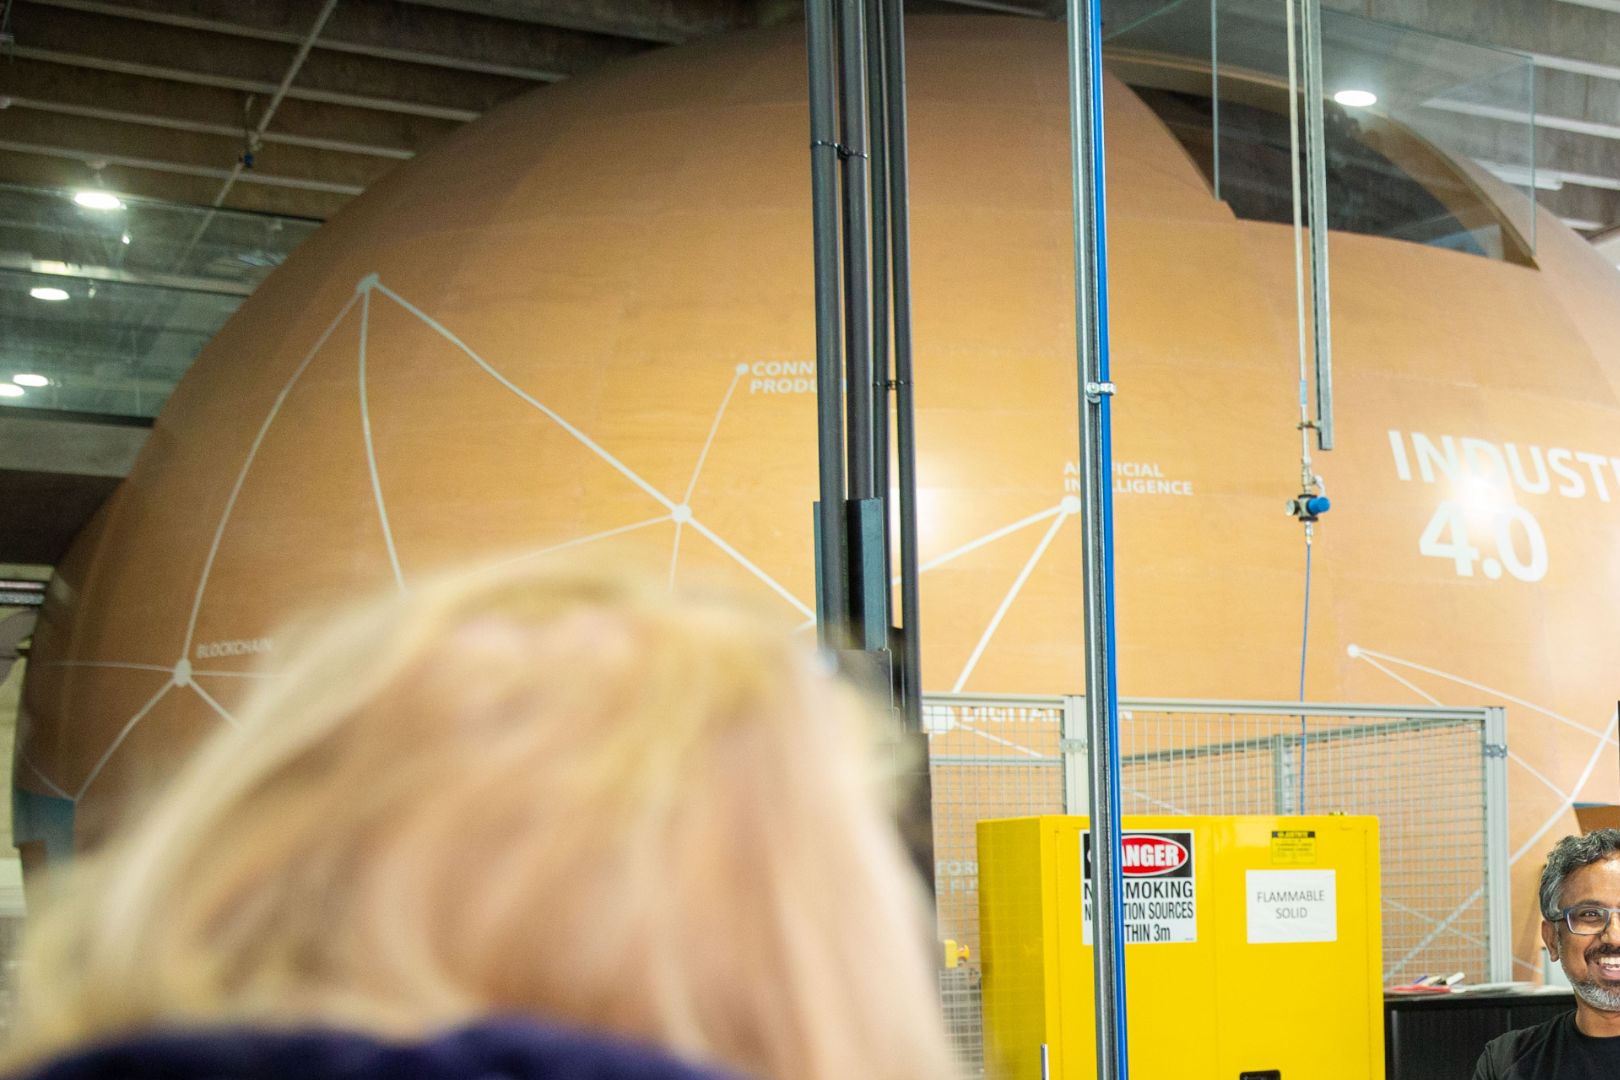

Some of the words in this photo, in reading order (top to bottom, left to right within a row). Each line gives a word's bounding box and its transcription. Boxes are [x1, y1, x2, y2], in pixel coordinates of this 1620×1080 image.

[1064, 478, 1194, 496] INLIGENCE
[1418, 502, 1549, 583] 4.0
[1122, 881, 1193, 899] MOKING
[1257, 890, 1325, 903] FLAMMABLE
[1123, 902, 1146, 920] TION
[1148, 901, 1193, 919] SOURCES
[1275, 907, 1308, 919] SOLID
[1124, 924, 1150, 942] THIN
[1153, 924, 1171, 941] 3m
